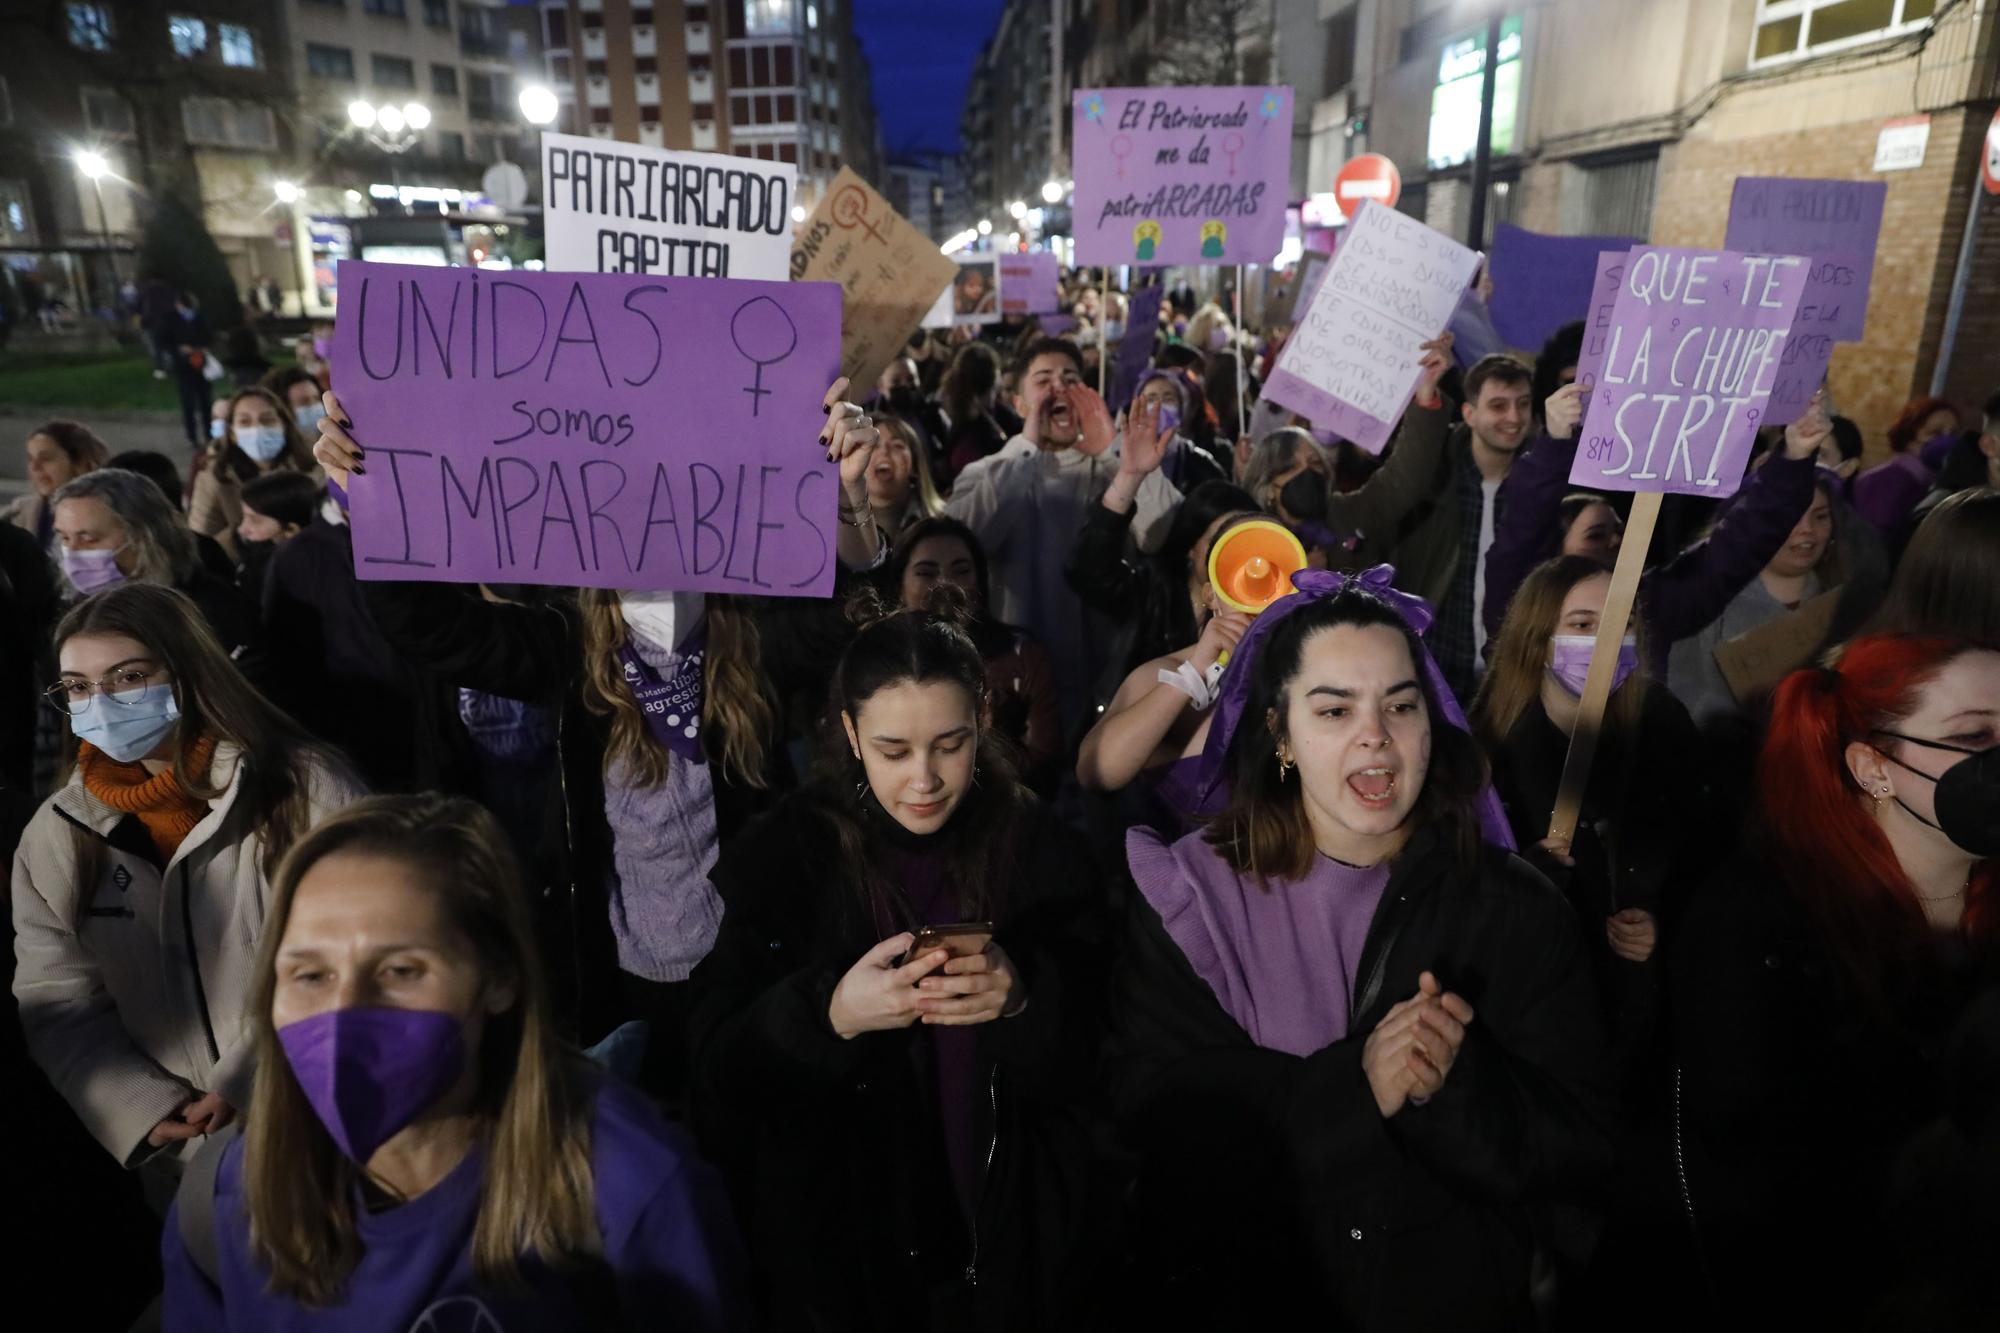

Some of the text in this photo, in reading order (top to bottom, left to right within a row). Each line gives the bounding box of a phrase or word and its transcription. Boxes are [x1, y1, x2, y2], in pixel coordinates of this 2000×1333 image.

[1118, 98, 1249, 131] El Patriarcado
[1154, 134, 1212, 165] me da
[549, 146, 788, 236] PATRIARCADO
[1096, 180, 1267, 231] patriARCADAS
[1629, 251, 1718, 306] QUE
[1739, 255, 1801, 308] TE
[1602, 325, 1791, 398] LA CHUPE
[1586, 437, 1616, 463] 8M
[1601, 392, 1752, 487] SIRI
[360, 445, 828, 589] IMPARABLES
[645, 685, 672, 698] Mateo
[672, 668, 702, 690] libre
